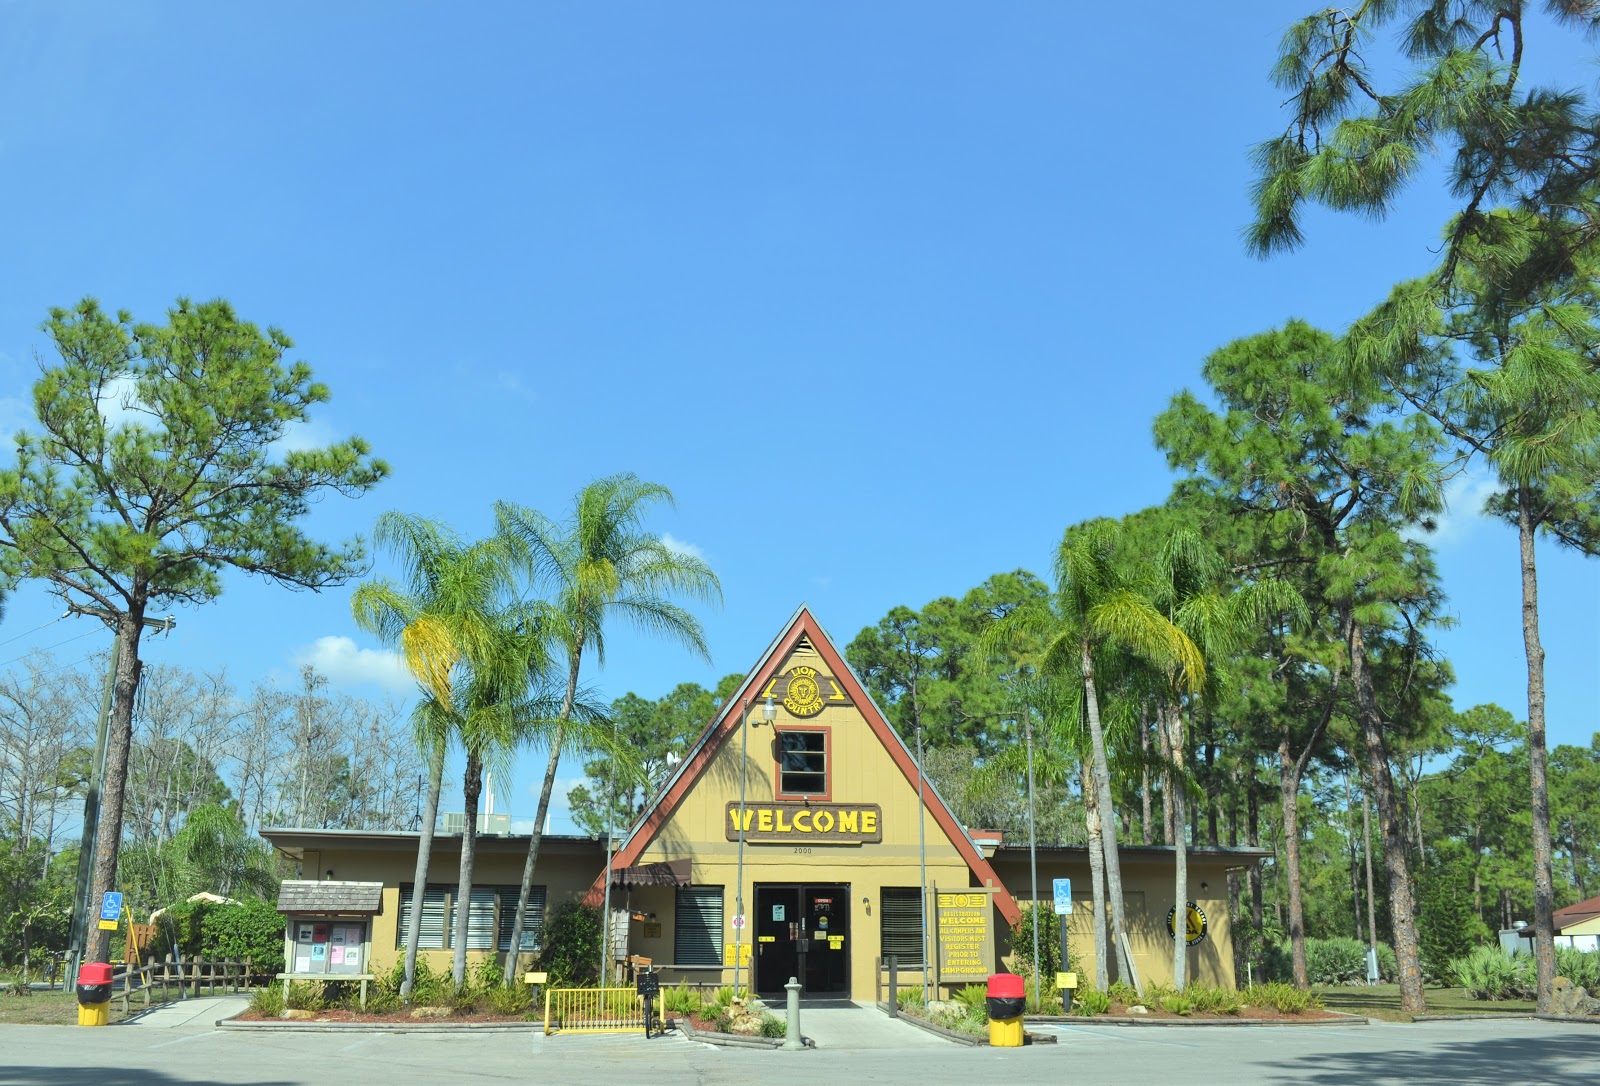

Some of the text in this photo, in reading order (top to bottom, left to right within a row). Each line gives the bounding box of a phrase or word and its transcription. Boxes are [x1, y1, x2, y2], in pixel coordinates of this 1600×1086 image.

[790, 667, 816, 678] LION
[783, 697, 824, 715] COUNTRY
[729, 808, 877, 833] WELCOME
